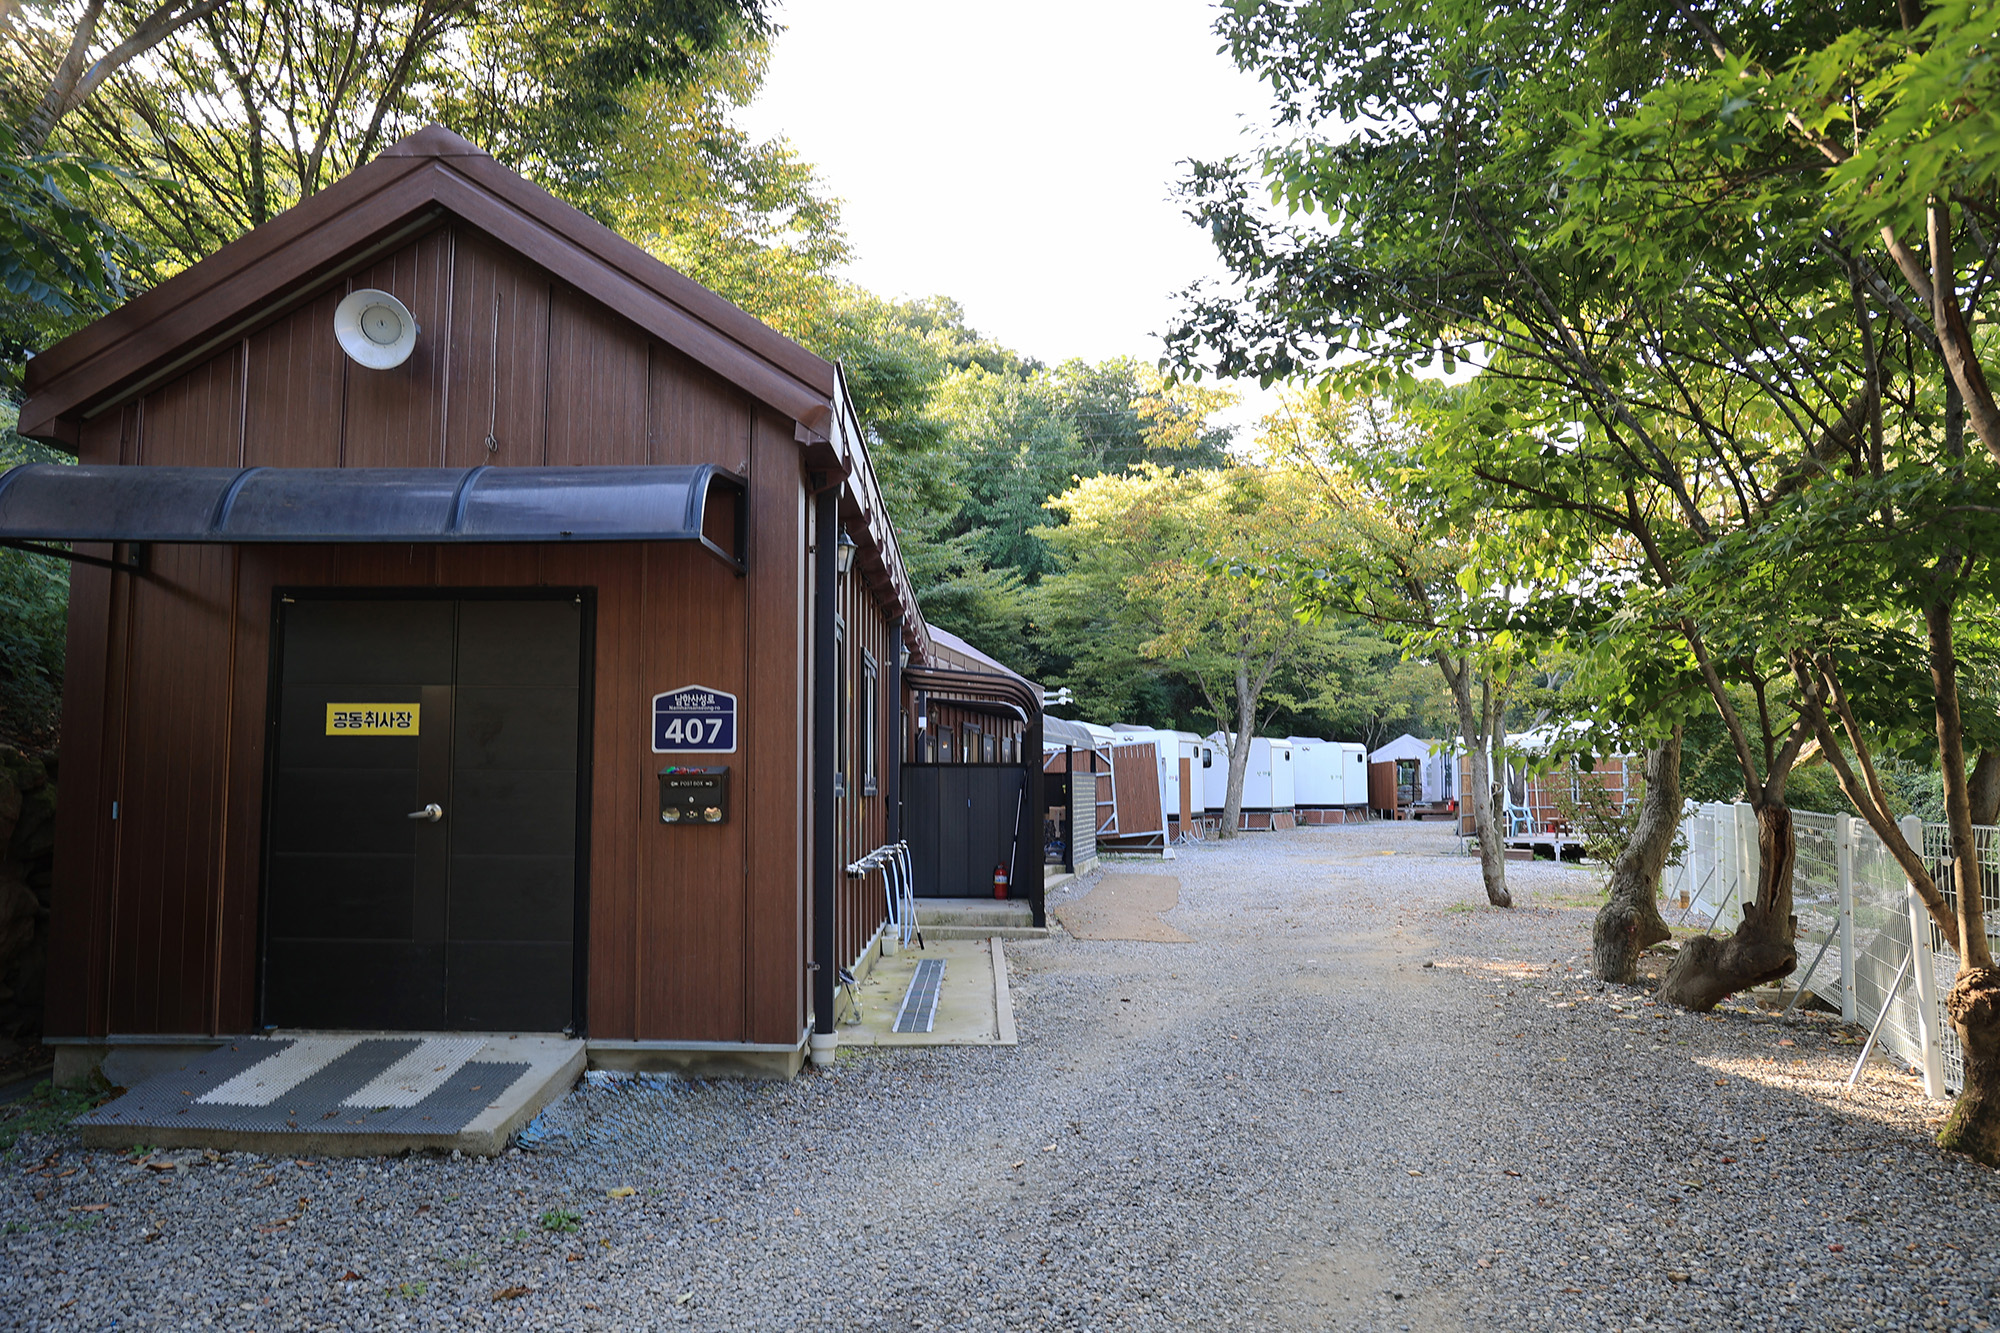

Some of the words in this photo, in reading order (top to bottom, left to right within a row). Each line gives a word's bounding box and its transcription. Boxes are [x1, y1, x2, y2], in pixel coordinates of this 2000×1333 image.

[674, 693, 716, 707] 남한산성로
[333, 711, 412, 728] 공동취사장
[665, 718, 723, 744] 407
